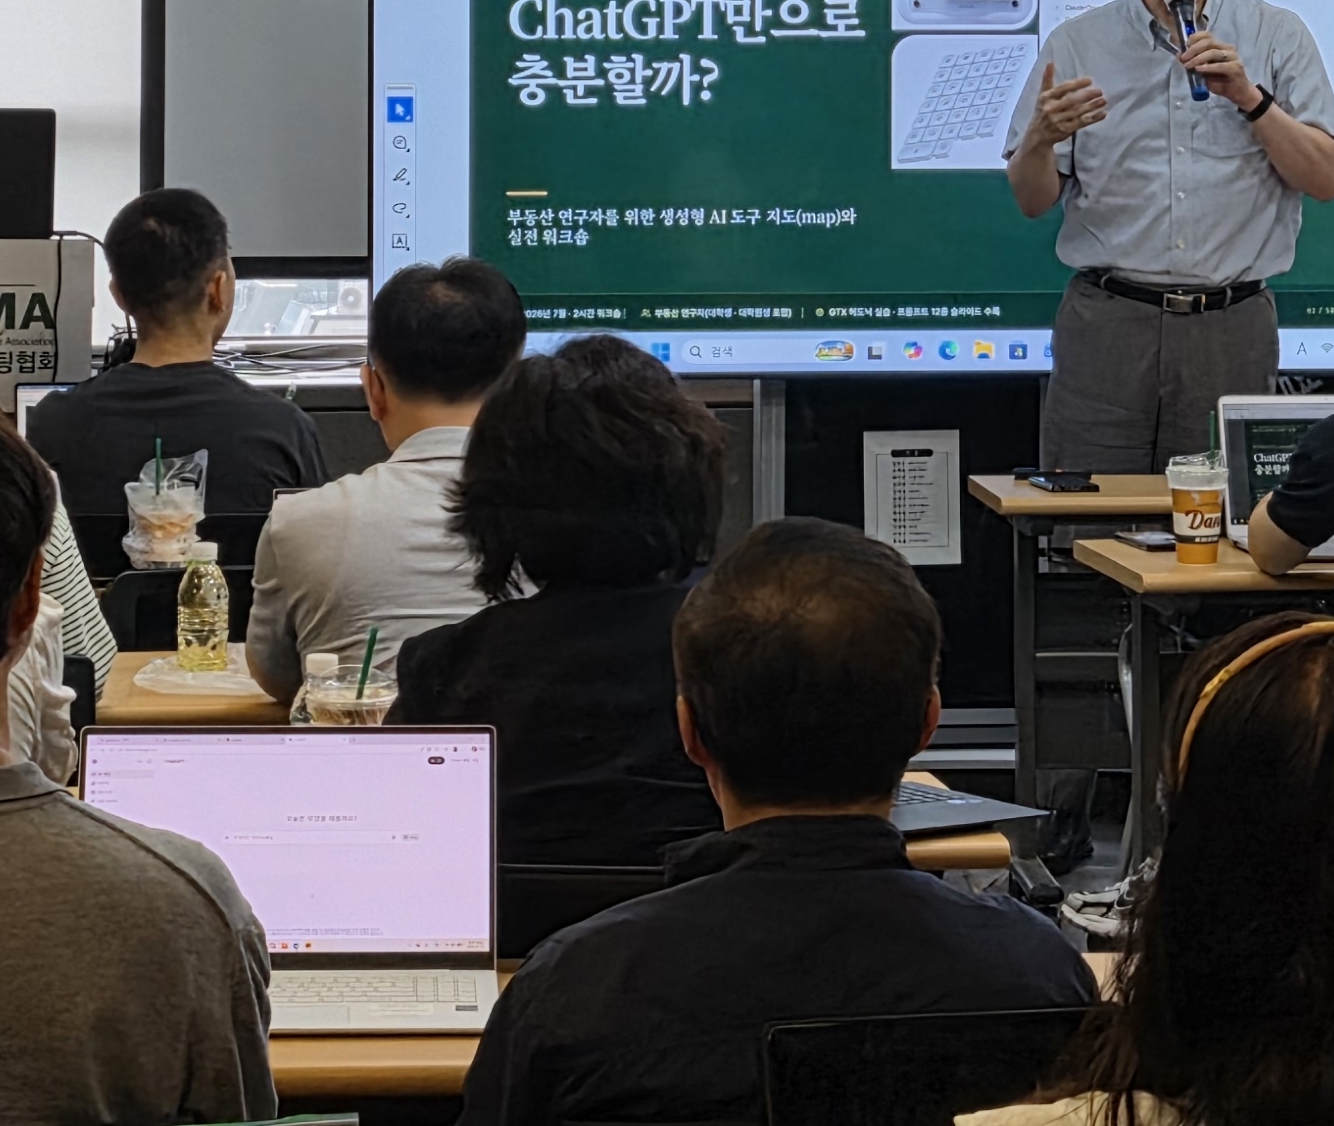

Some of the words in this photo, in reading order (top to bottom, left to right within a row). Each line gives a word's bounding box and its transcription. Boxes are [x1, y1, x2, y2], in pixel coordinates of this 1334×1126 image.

[507, 54, 719, 106] 충분할까?
[508, 208, 553, 226] 부동산
[558, 208, 619, 226] 연구자를
[624, 208, 655, 226] 위한
[659, 208, 705, 226] 생성형
[709, 210, 726, 224] AI
[730, 208, 761, 226] 도구
[766, 208, 857, 228] 지도(map)와
[508, 229, 538, 246] 실전
[542, 229, 590, 246] 워크숍
[573, 308, 595, 319] 2시간
[711, 346, 733, 358] 검색
